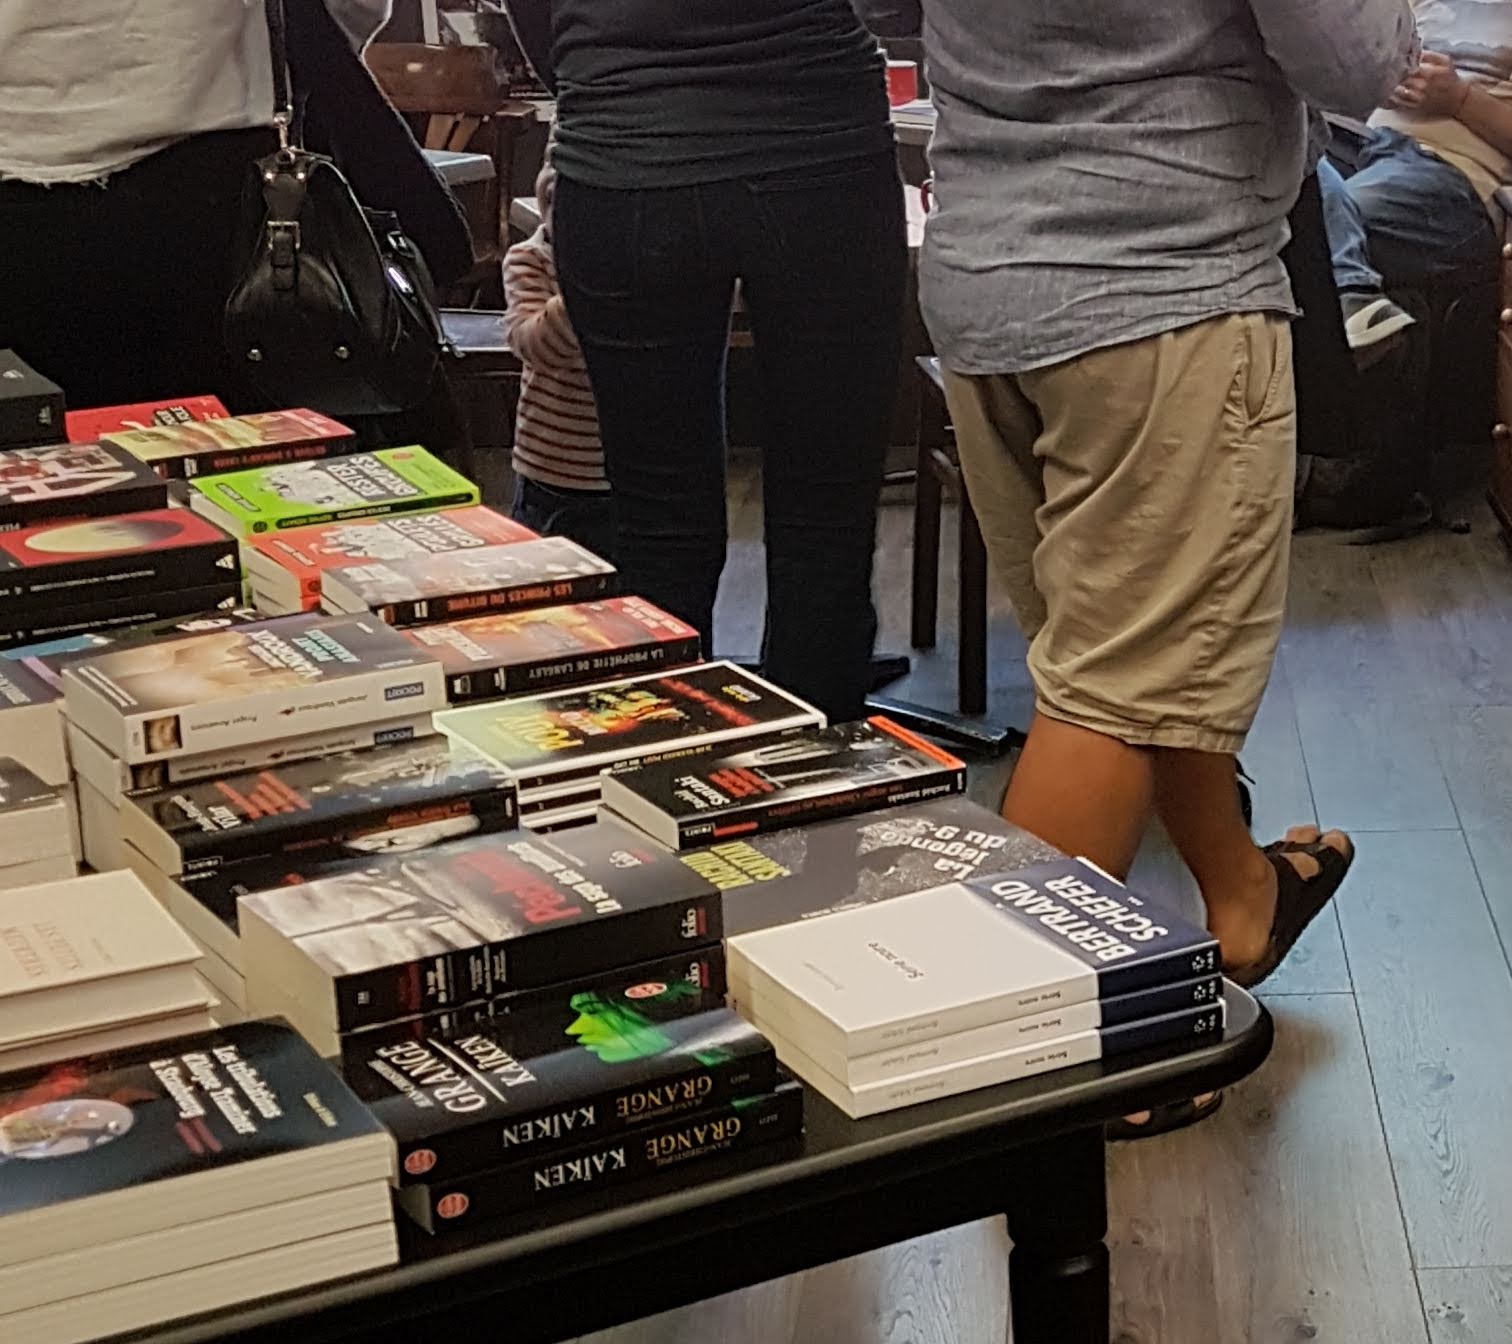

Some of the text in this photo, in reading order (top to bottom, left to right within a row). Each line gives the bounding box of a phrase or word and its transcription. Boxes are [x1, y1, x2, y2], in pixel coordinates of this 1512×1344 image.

[964, 832, 1008, 851] du
[934, 859, 976, 881] La
[990, 879, 1136, 962] BERTRAND
[1044, 874, 1168, 940] SCHEFER
[454, 1034, 537, 1087] KAÏKEN
[502, 1105, 596, 1148] KAÏKEN
[533, 1147, 627, 1193] KAÏKEN
